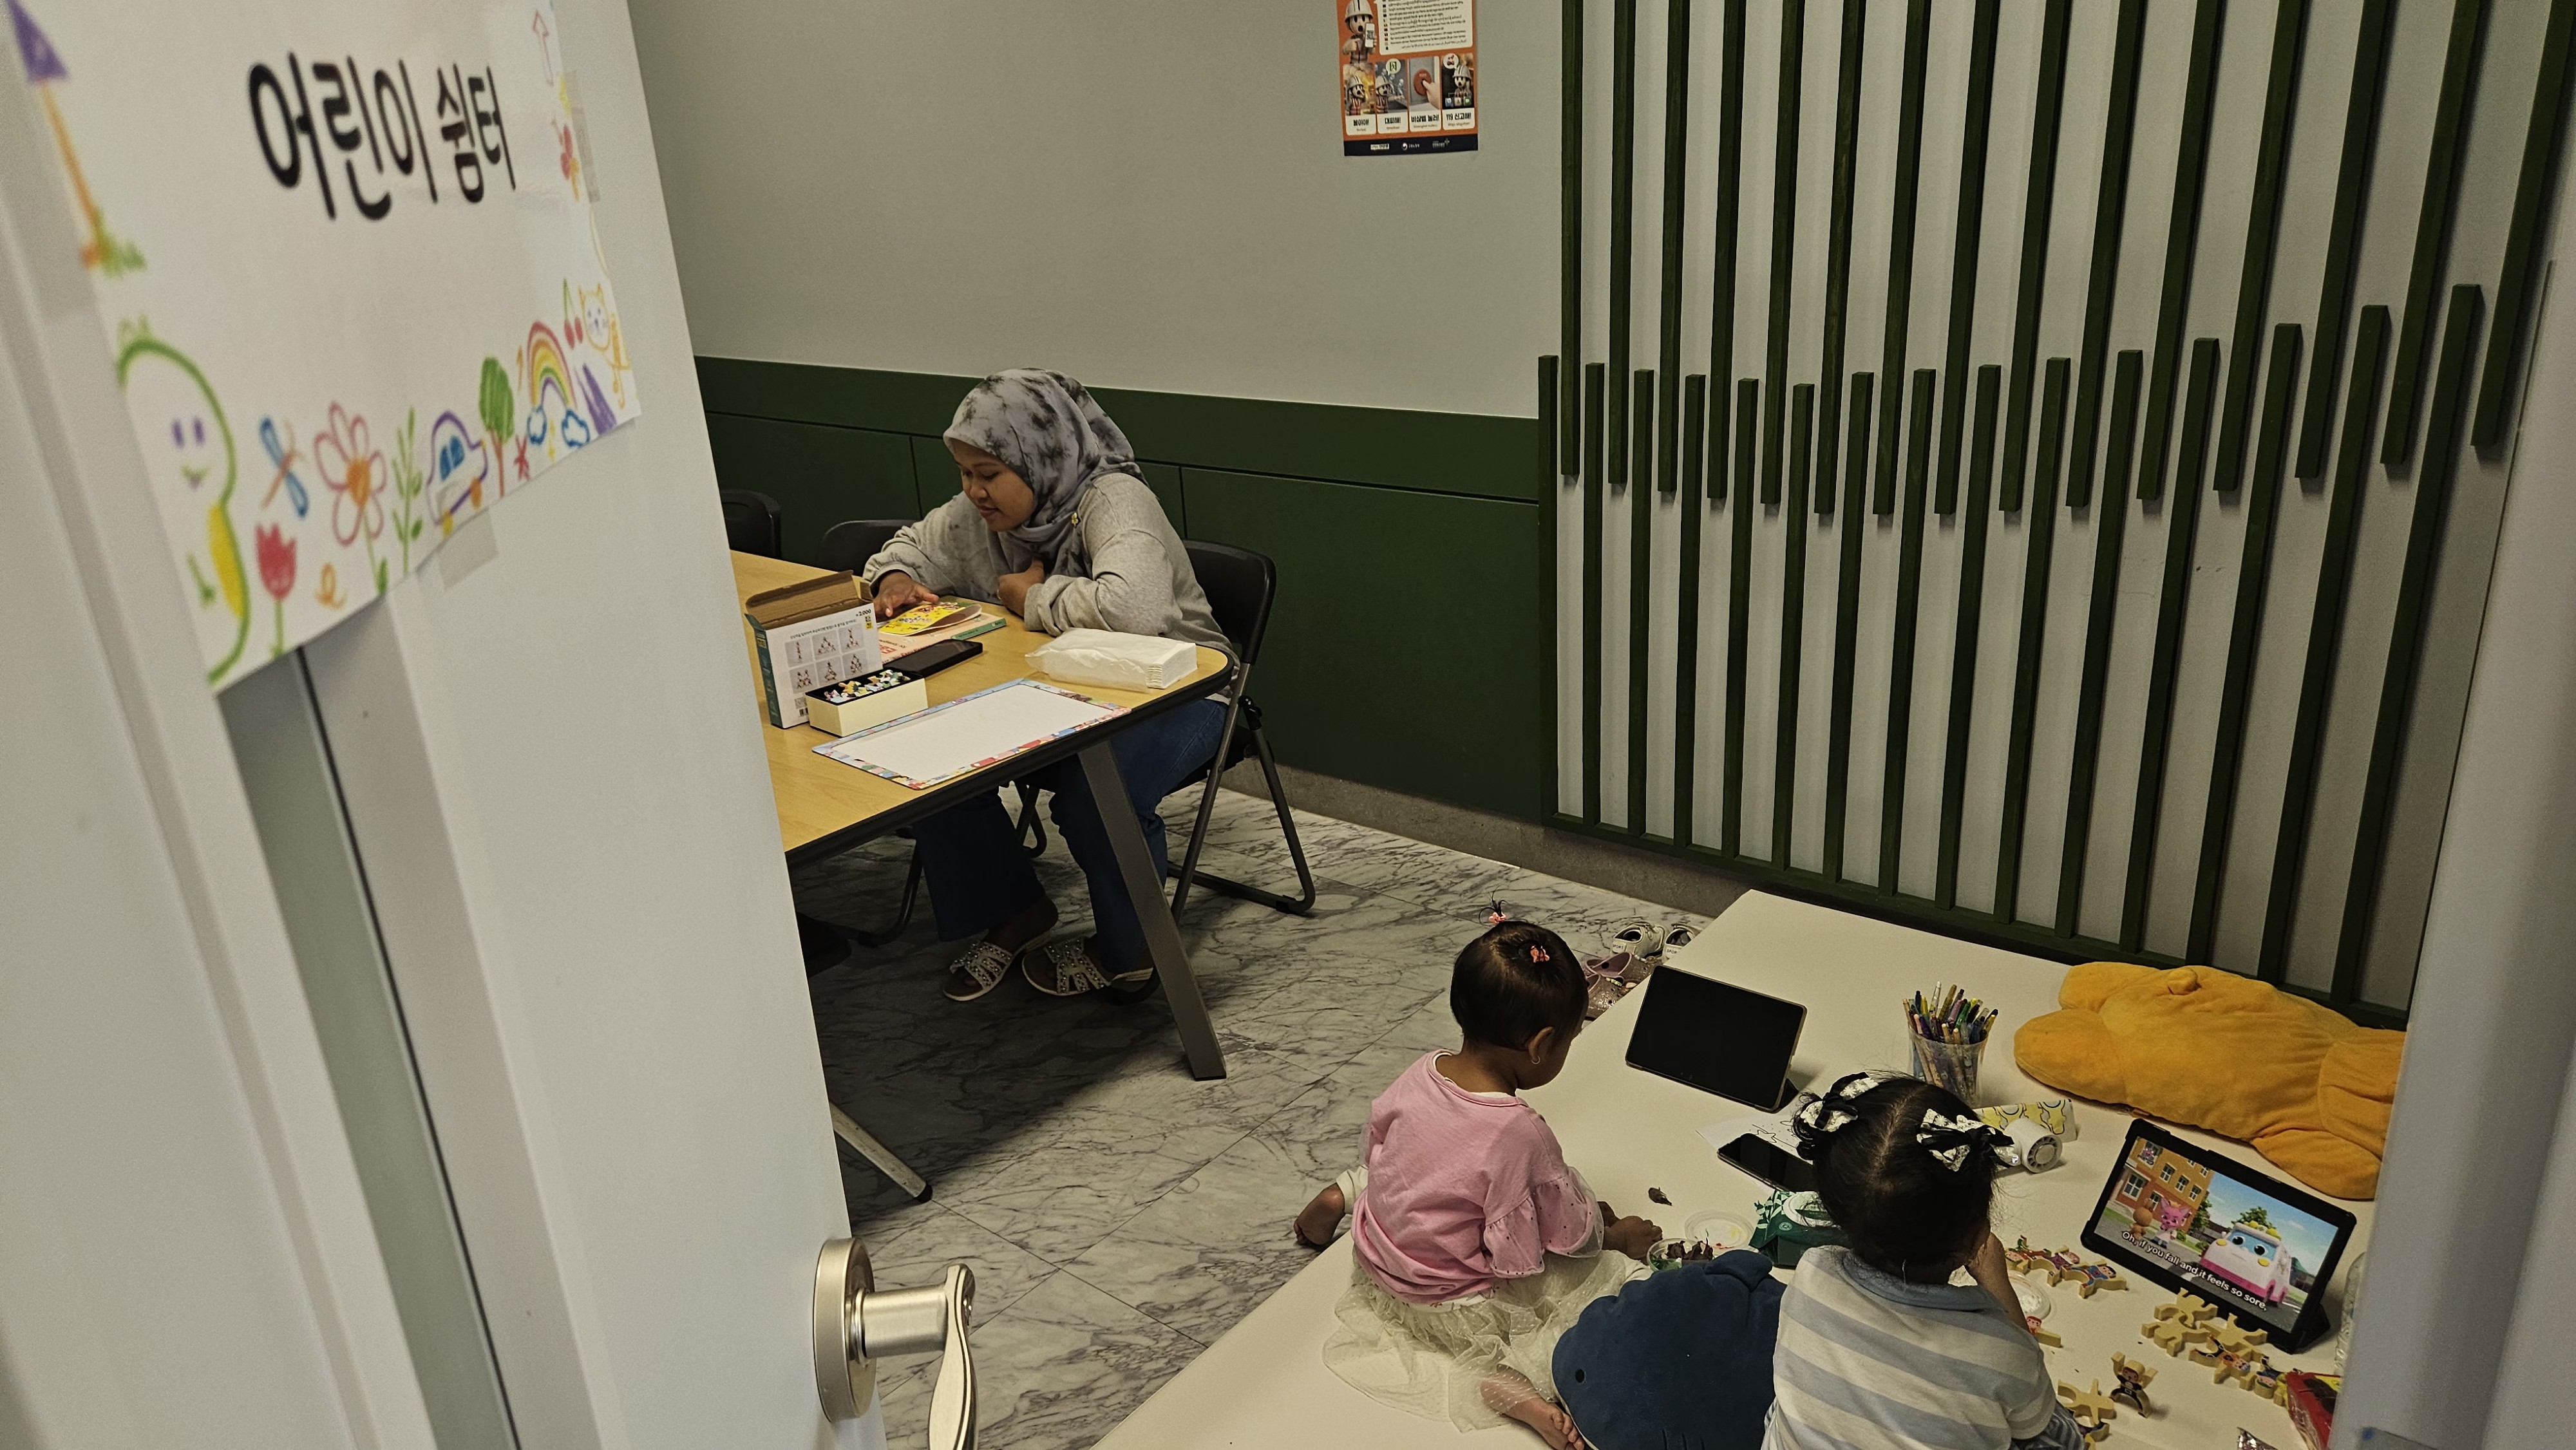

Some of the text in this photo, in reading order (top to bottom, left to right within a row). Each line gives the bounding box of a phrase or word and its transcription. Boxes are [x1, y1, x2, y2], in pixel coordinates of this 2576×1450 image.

[247, 50, 516, 221] 어린이 쉼터
[2122, 1231, 2137, 1245] Oh,
[2145, 1245, 2164, 1257] you
[2164, 1253, 2180, 1265] fall
[2199, 1270, 2206, 1279] it
[2207, 1274, 2230, 1291] feels
[2230, 1287, 2243, 1297] so
[2243, 1294, 2267, 1312] sore,
